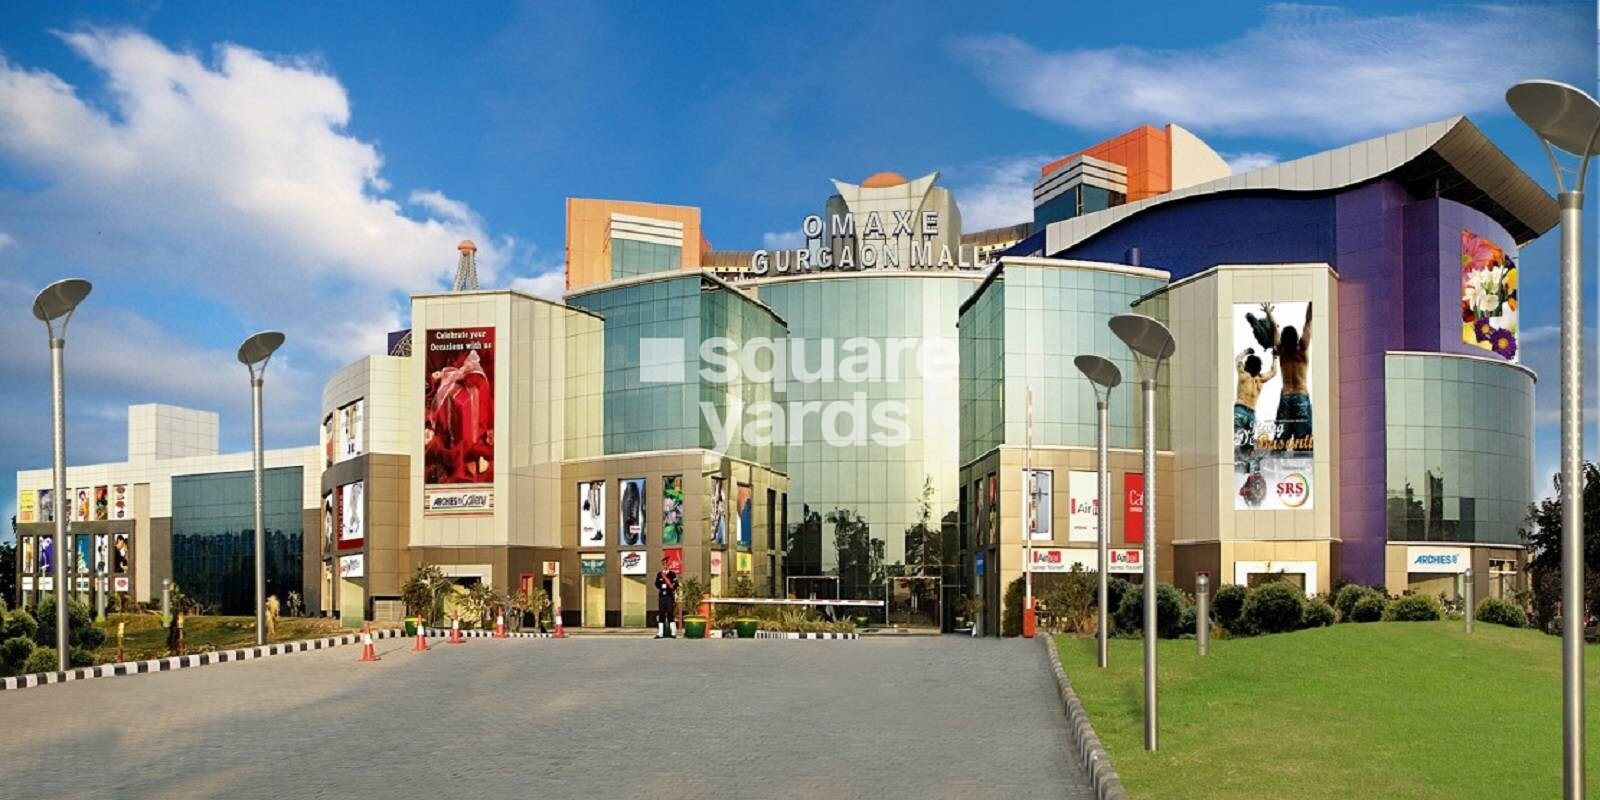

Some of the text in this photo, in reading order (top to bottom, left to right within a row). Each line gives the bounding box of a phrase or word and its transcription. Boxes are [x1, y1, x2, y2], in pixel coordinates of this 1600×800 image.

[803, 211, 939, 240] OMAXE
[751, 240, 984, 276] GURGAON MALL
[436, 331, 487, 340] Celebrate your
[430, 342, 464, 351] Occasions
[465, 341, 482, 350] with
[1276, 482, 1304, 494] SRS
[1414, 554, 1452, 564] ARCHIES
